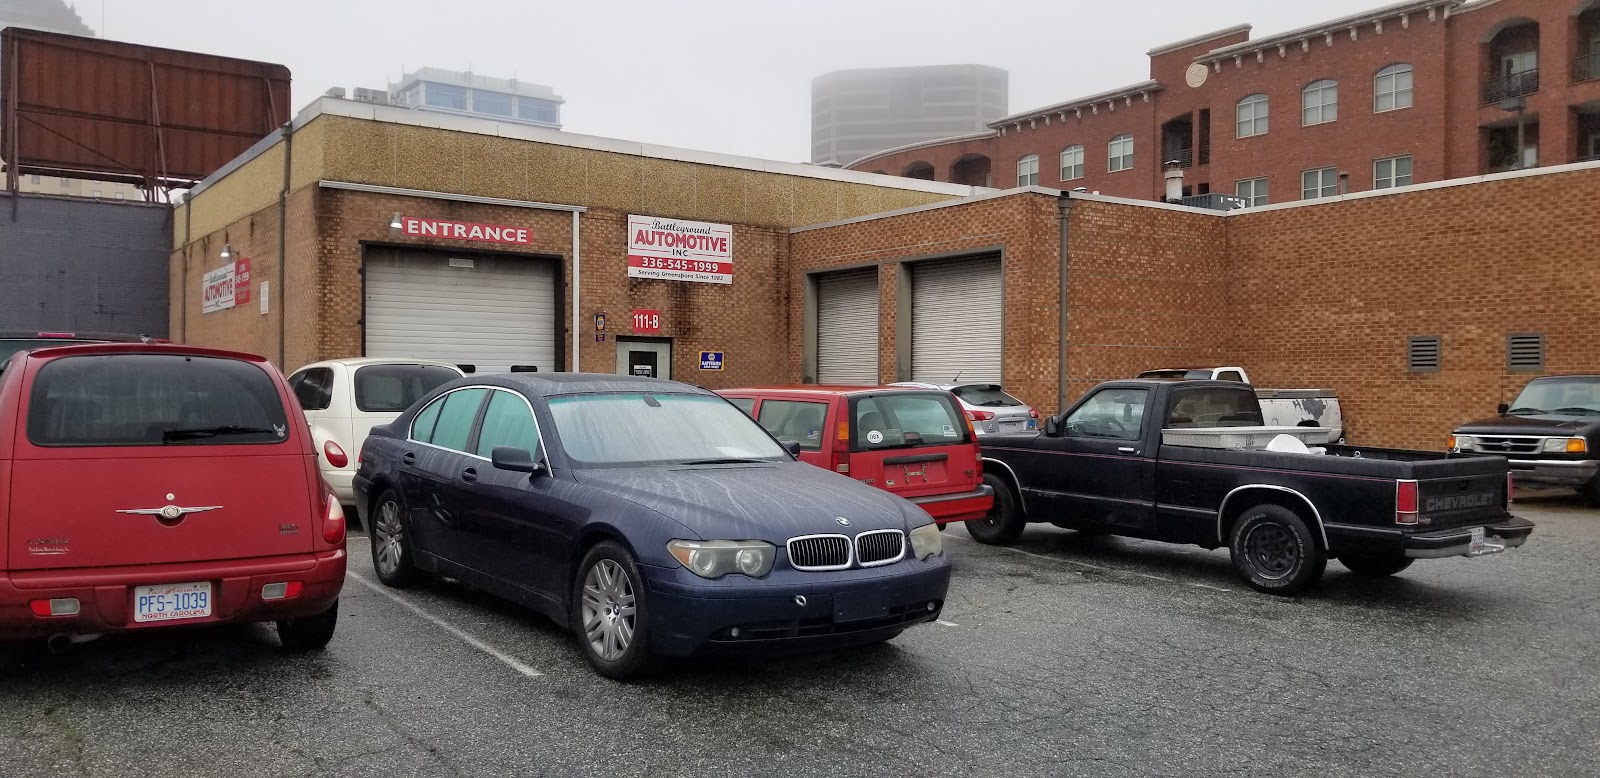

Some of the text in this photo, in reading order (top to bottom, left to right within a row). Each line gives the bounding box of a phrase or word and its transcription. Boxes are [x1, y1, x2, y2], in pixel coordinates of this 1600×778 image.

[407, 219, 528, 243] ENTRANCE
[651, 220, 711, 235] Battleground
[635, 230, 727, 252] AUTOMOTIVE
[637, 269, 660, 277] Serving
[642, 257, 719, 273] 336-545-1999
[633, 313, 659, 329] 111-B
[1426, 493, 1494, 511] CHEVROLET
[139, 591, 207, 613] PFS-1039
[170, 609, 205, 617] CAROLINA
